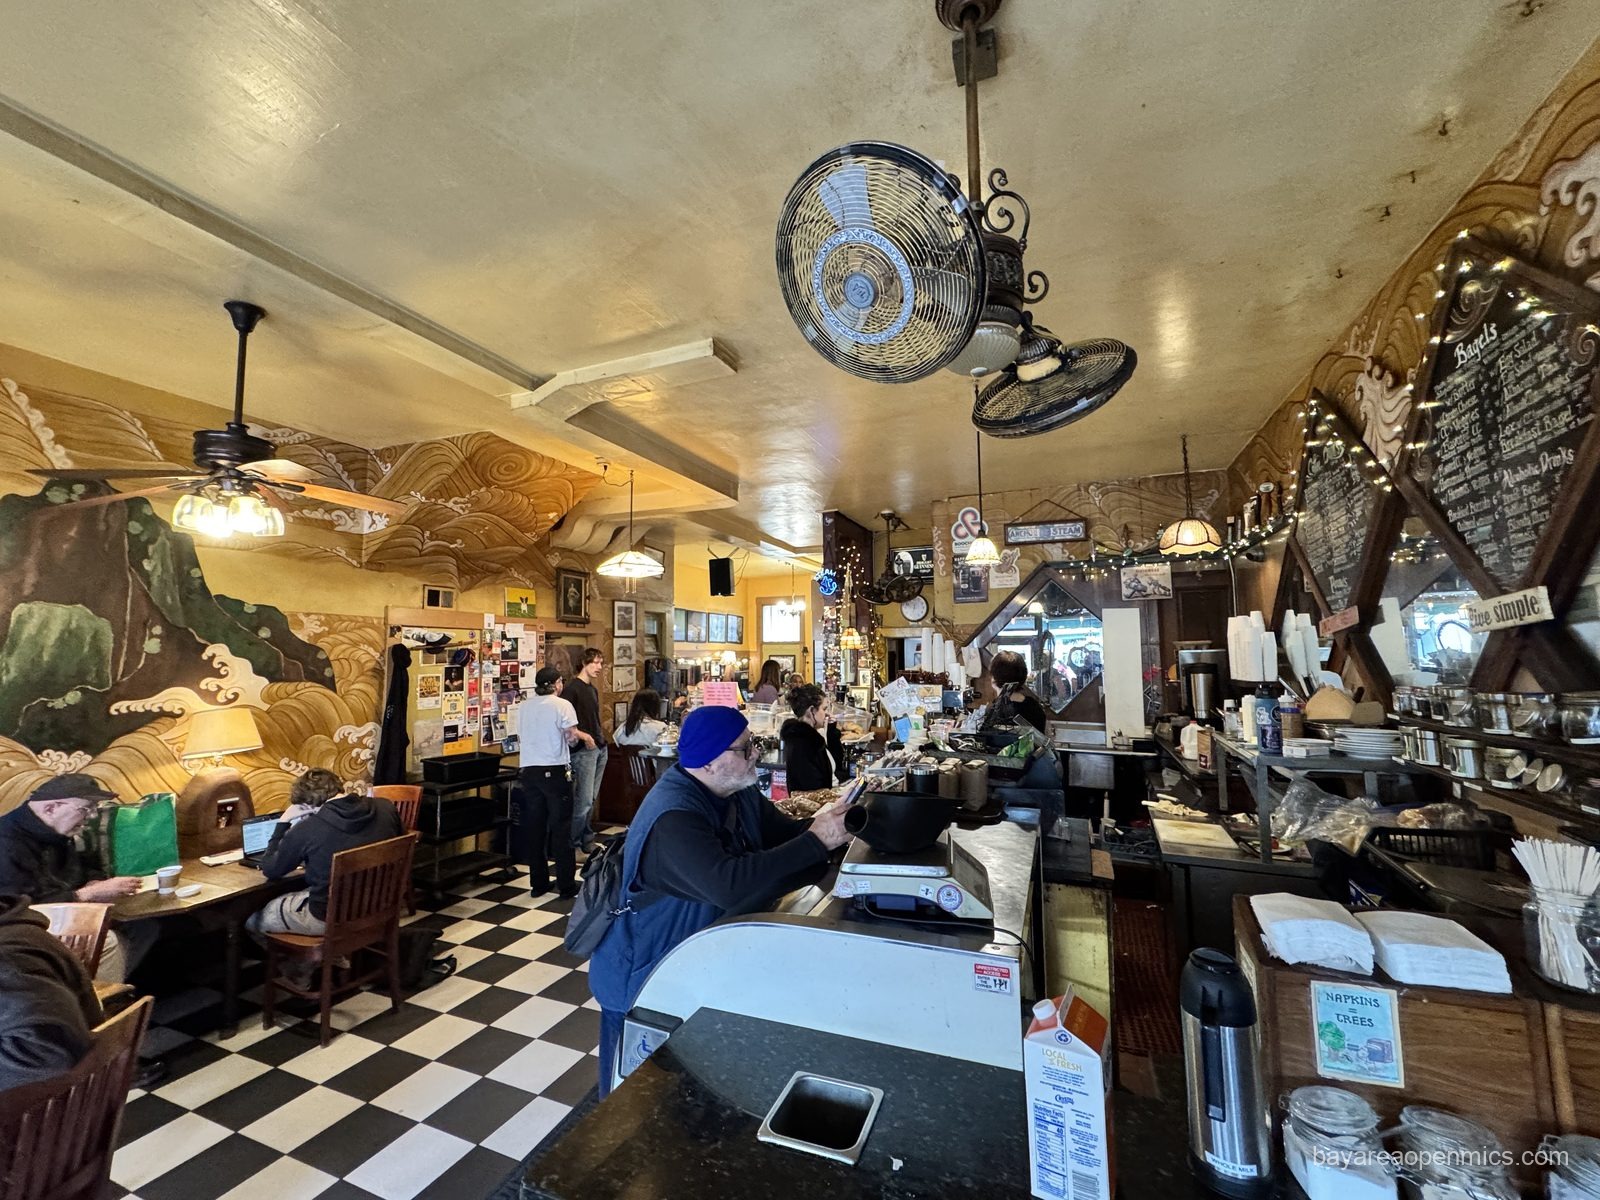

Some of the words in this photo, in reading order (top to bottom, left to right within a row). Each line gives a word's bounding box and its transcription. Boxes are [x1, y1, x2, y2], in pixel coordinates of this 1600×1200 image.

[1454, 323, 1497, 369] Bagels
[1512, 330, 1540, 358] Salad
[1539, 447, 1576, 476] Drinks
[1052, 524, 1081, 536] STEAM
[1493, 594, 1540, 623] simple
[1326, 992, 1380, 1008] NAPKINS
[1335, 1013, 1374, 1028] TREES
[1042, 1048, 1066, 1060] LOCAL
[1056, 1059, 1082, 1071] FRESH
[1211, 1157, 1236, 1170] WHOLE
